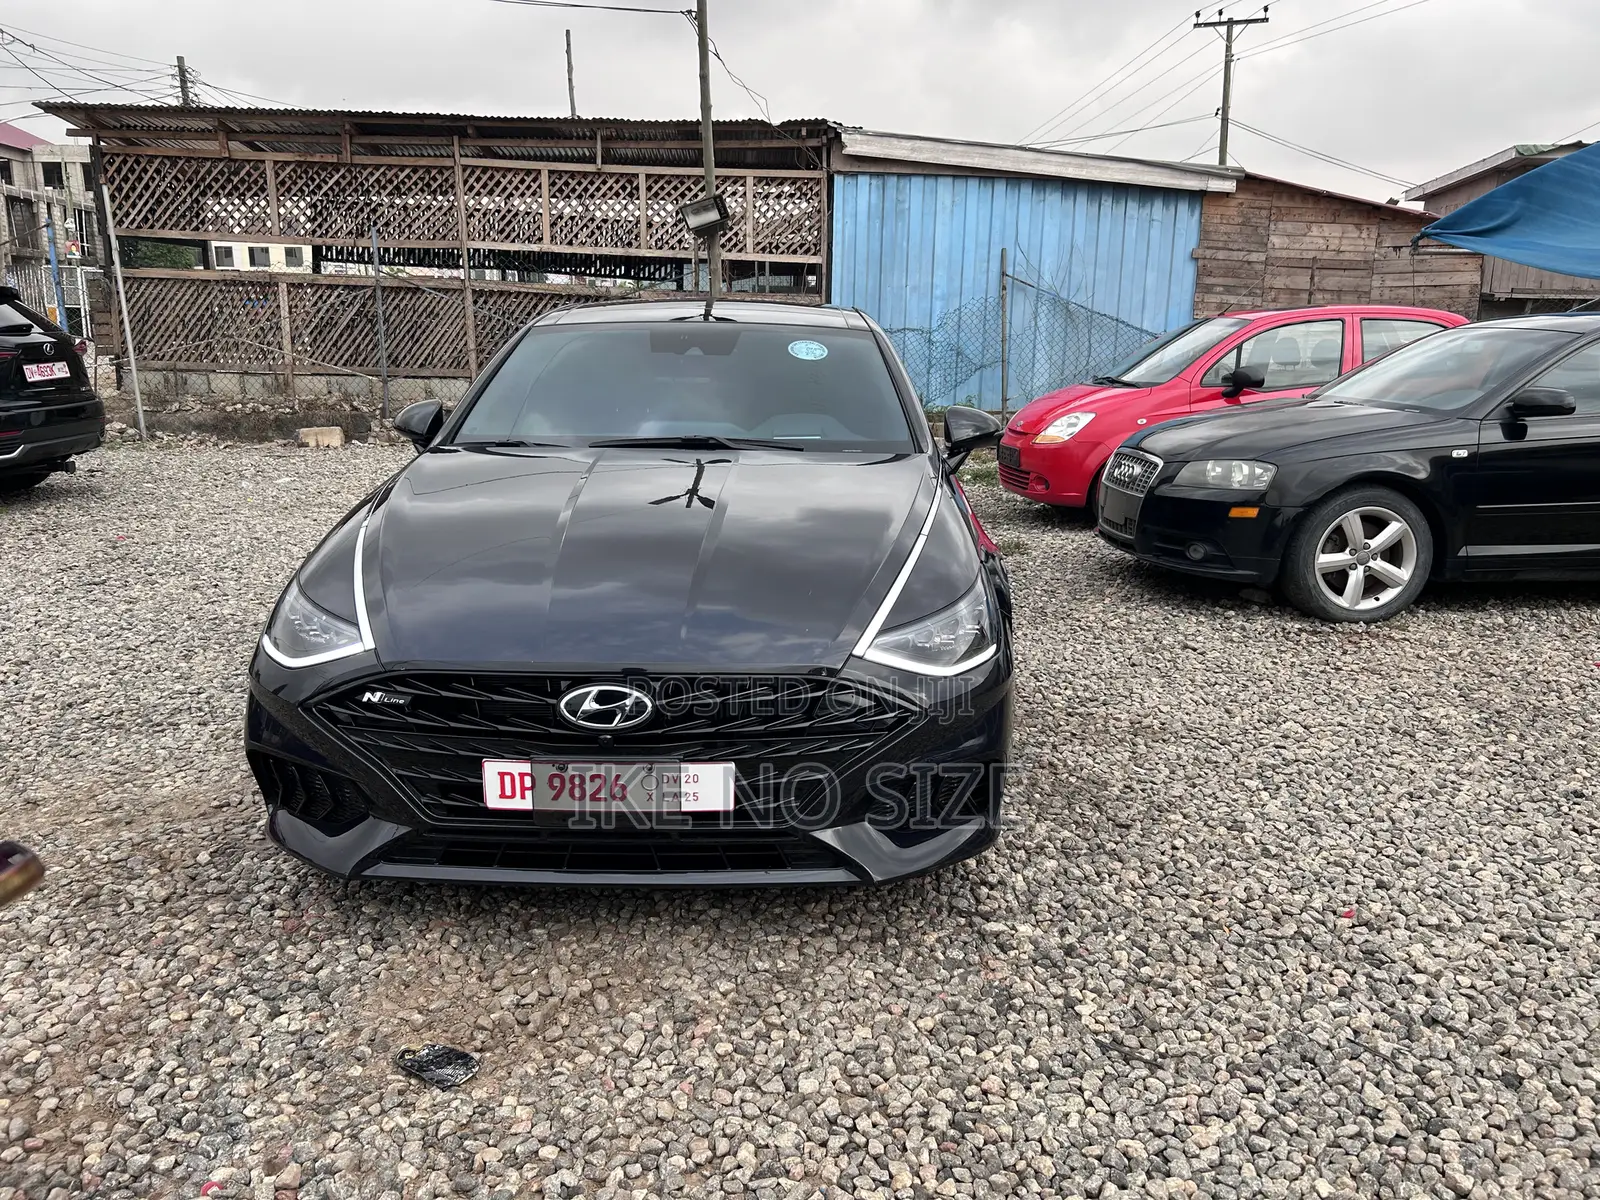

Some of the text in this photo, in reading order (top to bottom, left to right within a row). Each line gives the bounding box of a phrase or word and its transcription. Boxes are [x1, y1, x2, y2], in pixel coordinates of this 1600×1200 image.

[362, 691, 384, 703] N
[684, 773, 699, 784] 20
[498, 771, 628, 802] DP 9826
[684, 792, 699, 802] 25
